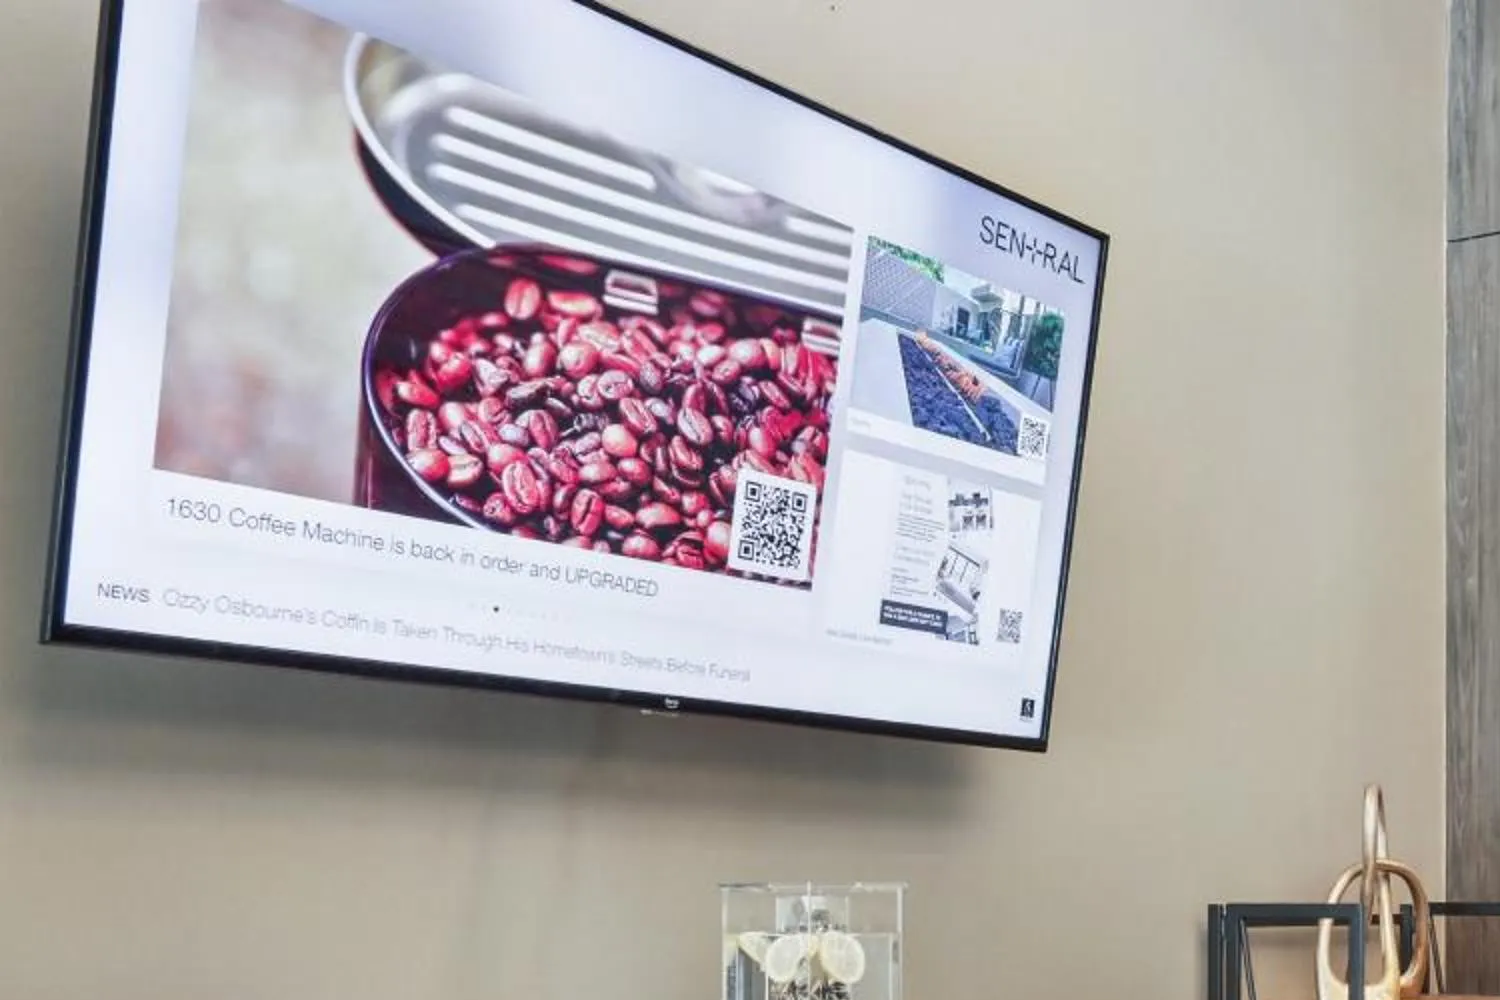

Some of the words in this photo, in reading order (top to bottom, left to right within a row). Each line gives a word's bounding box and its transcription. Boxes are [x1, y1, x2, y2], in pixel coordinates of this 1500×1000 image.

[167, 498, 221, 523] 1630
[228, 507, 296, 536] Coffee
[303, 520, 385, 551] Machine
[390, 535, 404, 555] is
[409, 539, 455, 562] back
[460, 550, 475, 566] in
[480, 555, 524, 573] order
[529, 562, 561, 581] and
[565, 566, 659, 597] UPGRADED
[97, 583, 150, 603] NEWS
[162, 588, 209, 615] Ozzy
[214, 595, 317, 626] Osbourne's
[321, 609, 369, 632] Coffin
[392, 619, 438, 639] Taken
[443, 625, 501, 653] Through
